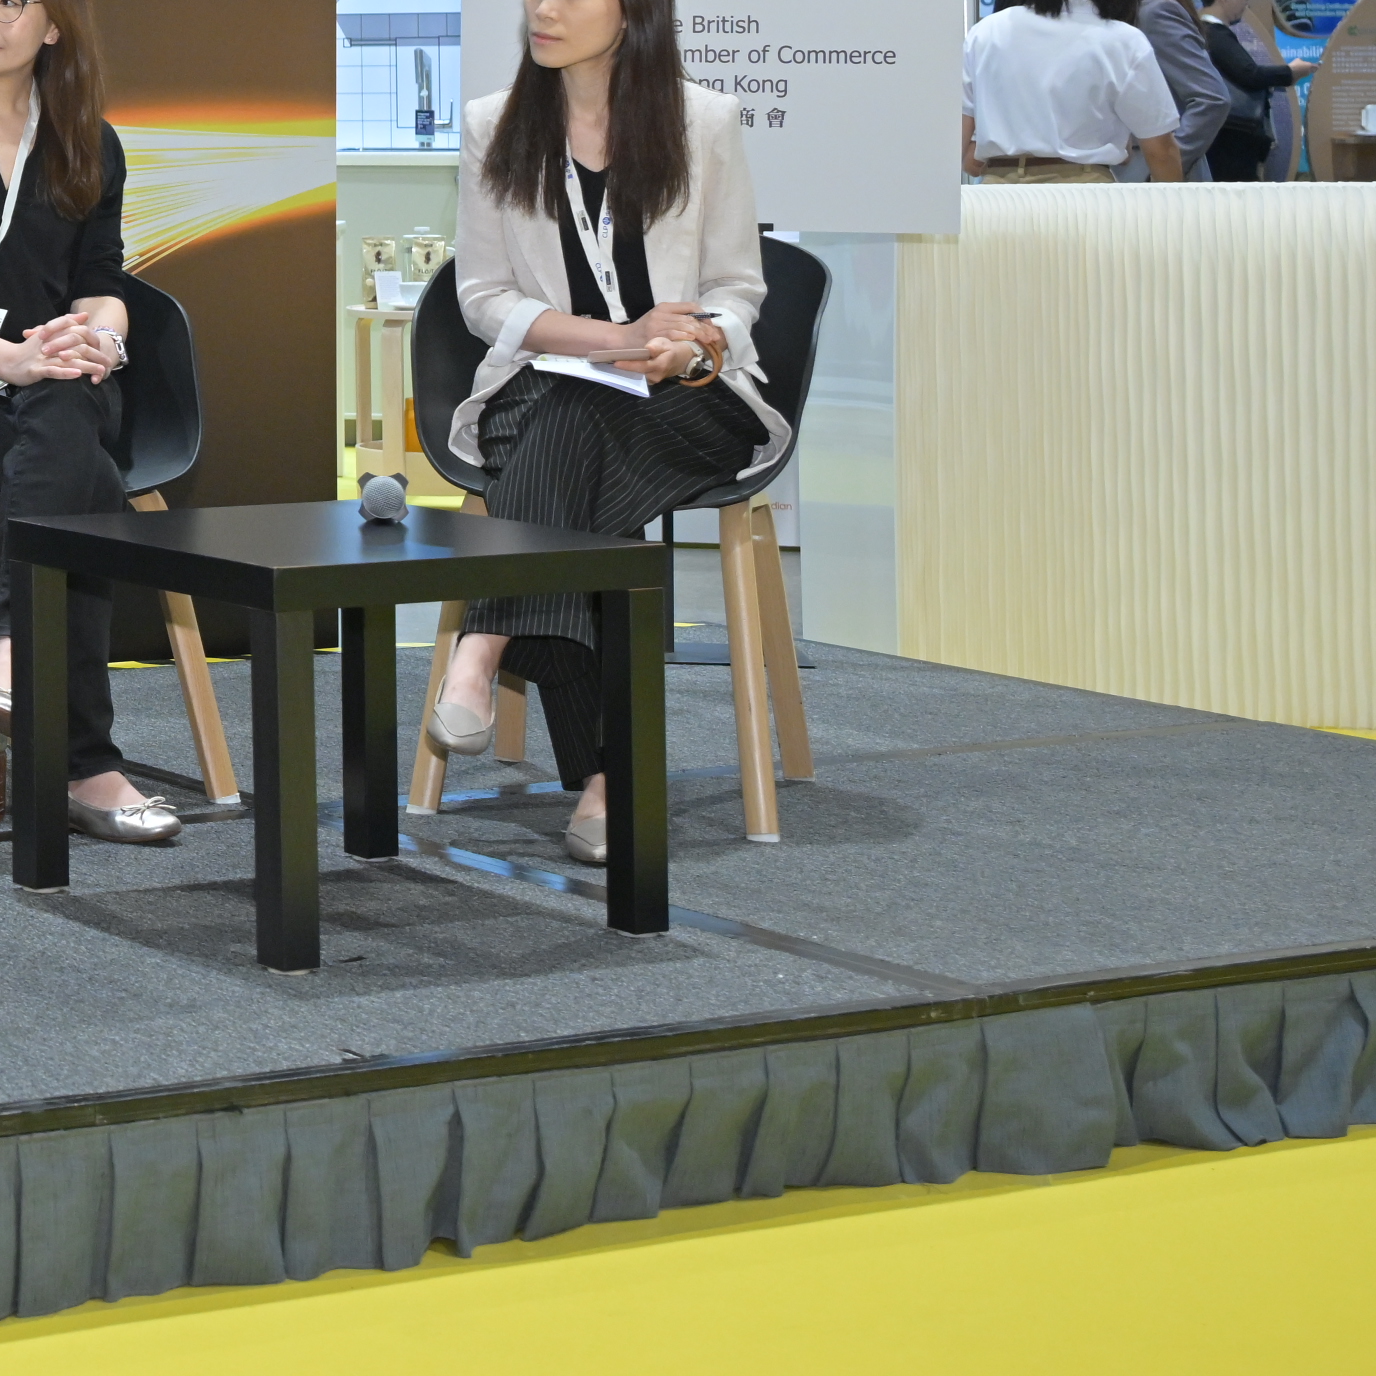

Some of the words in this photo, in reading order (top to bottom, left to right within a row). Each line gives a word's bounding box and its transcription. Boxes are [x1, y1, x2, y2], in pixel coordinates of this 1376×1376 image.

[692, 15, 760, 34] British
[683, 44, 740, 64] mber
[748, 44, 770, 64] of
[777, 45, 897, 65] Commerce
[734, 75, 788, 98] Kong
